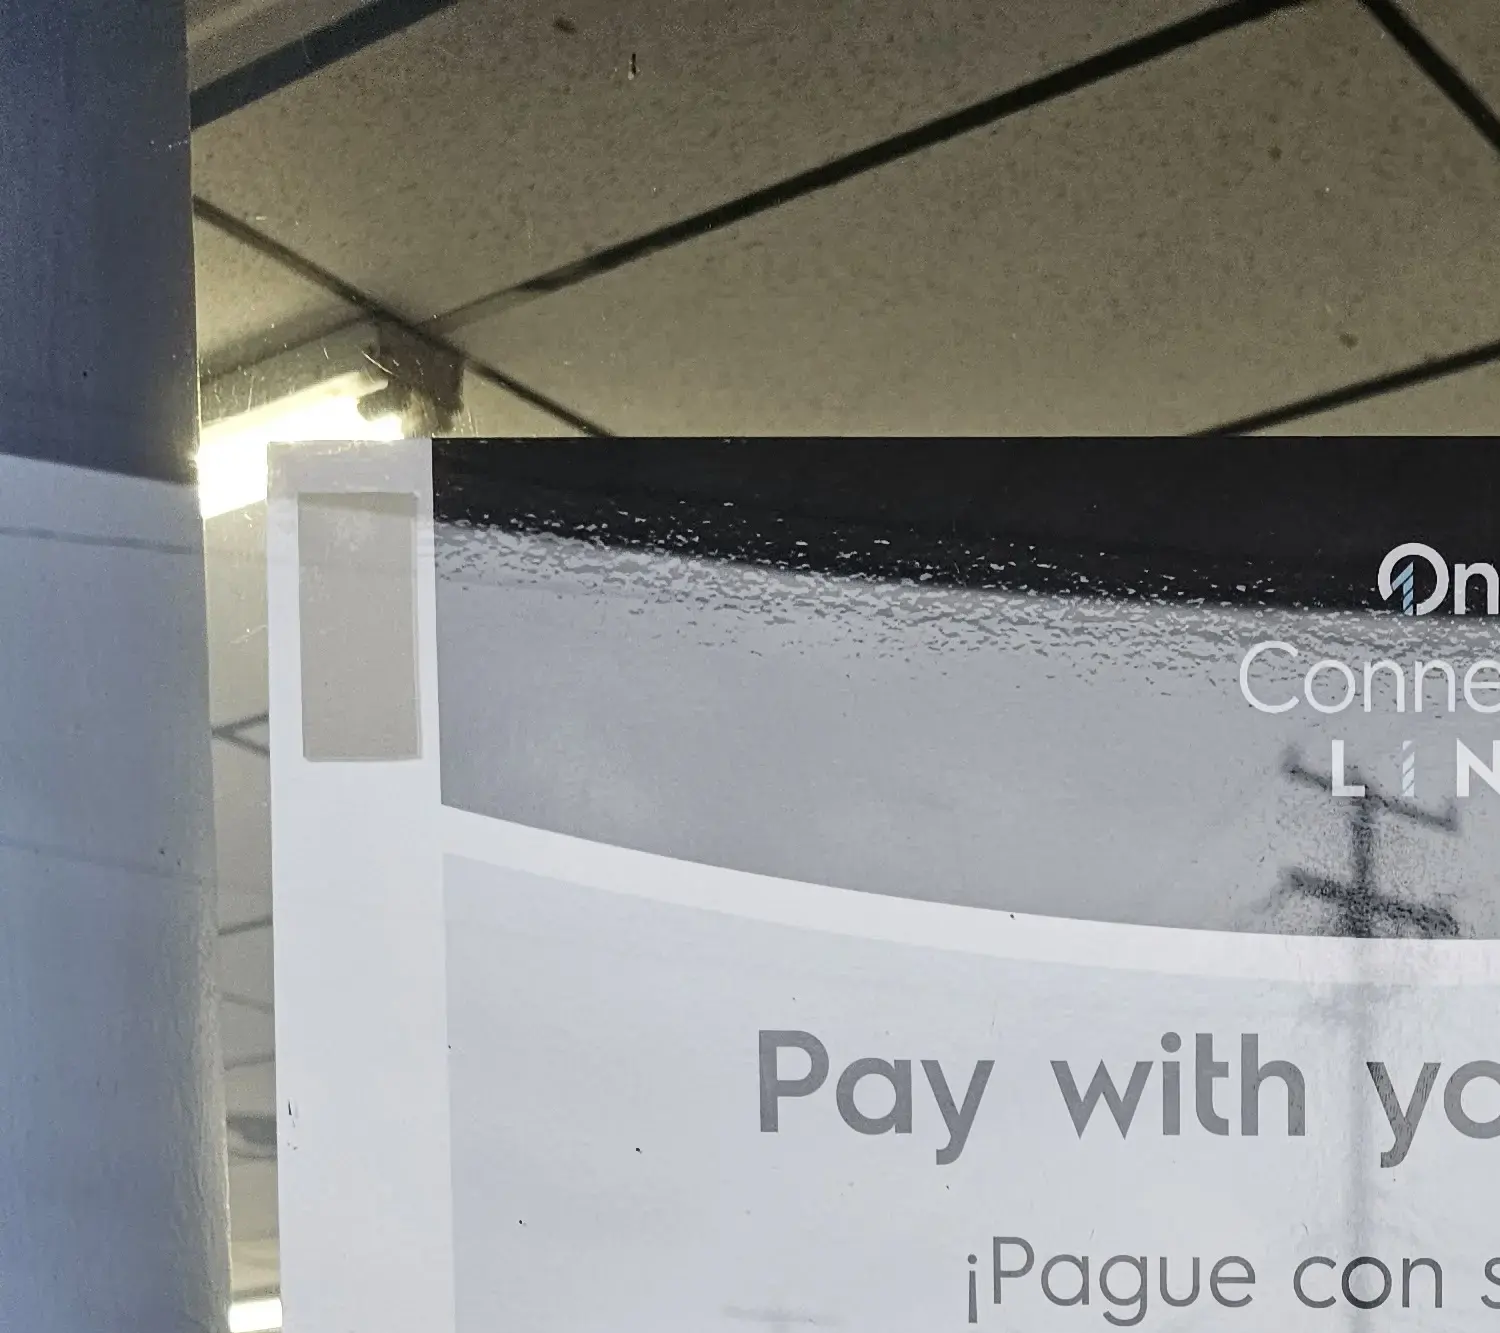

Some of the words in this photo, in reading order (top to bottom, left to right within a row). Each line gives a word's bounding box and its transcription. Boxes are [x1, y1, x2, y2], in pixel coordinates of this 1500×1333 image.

[758, 1030, 995, 1165] Pay
[1050, 1031, 1306, 1139] with
[966, 1236, 1255, 1327] ¡Pague
[1293, 1255, 1443, 1309] con
